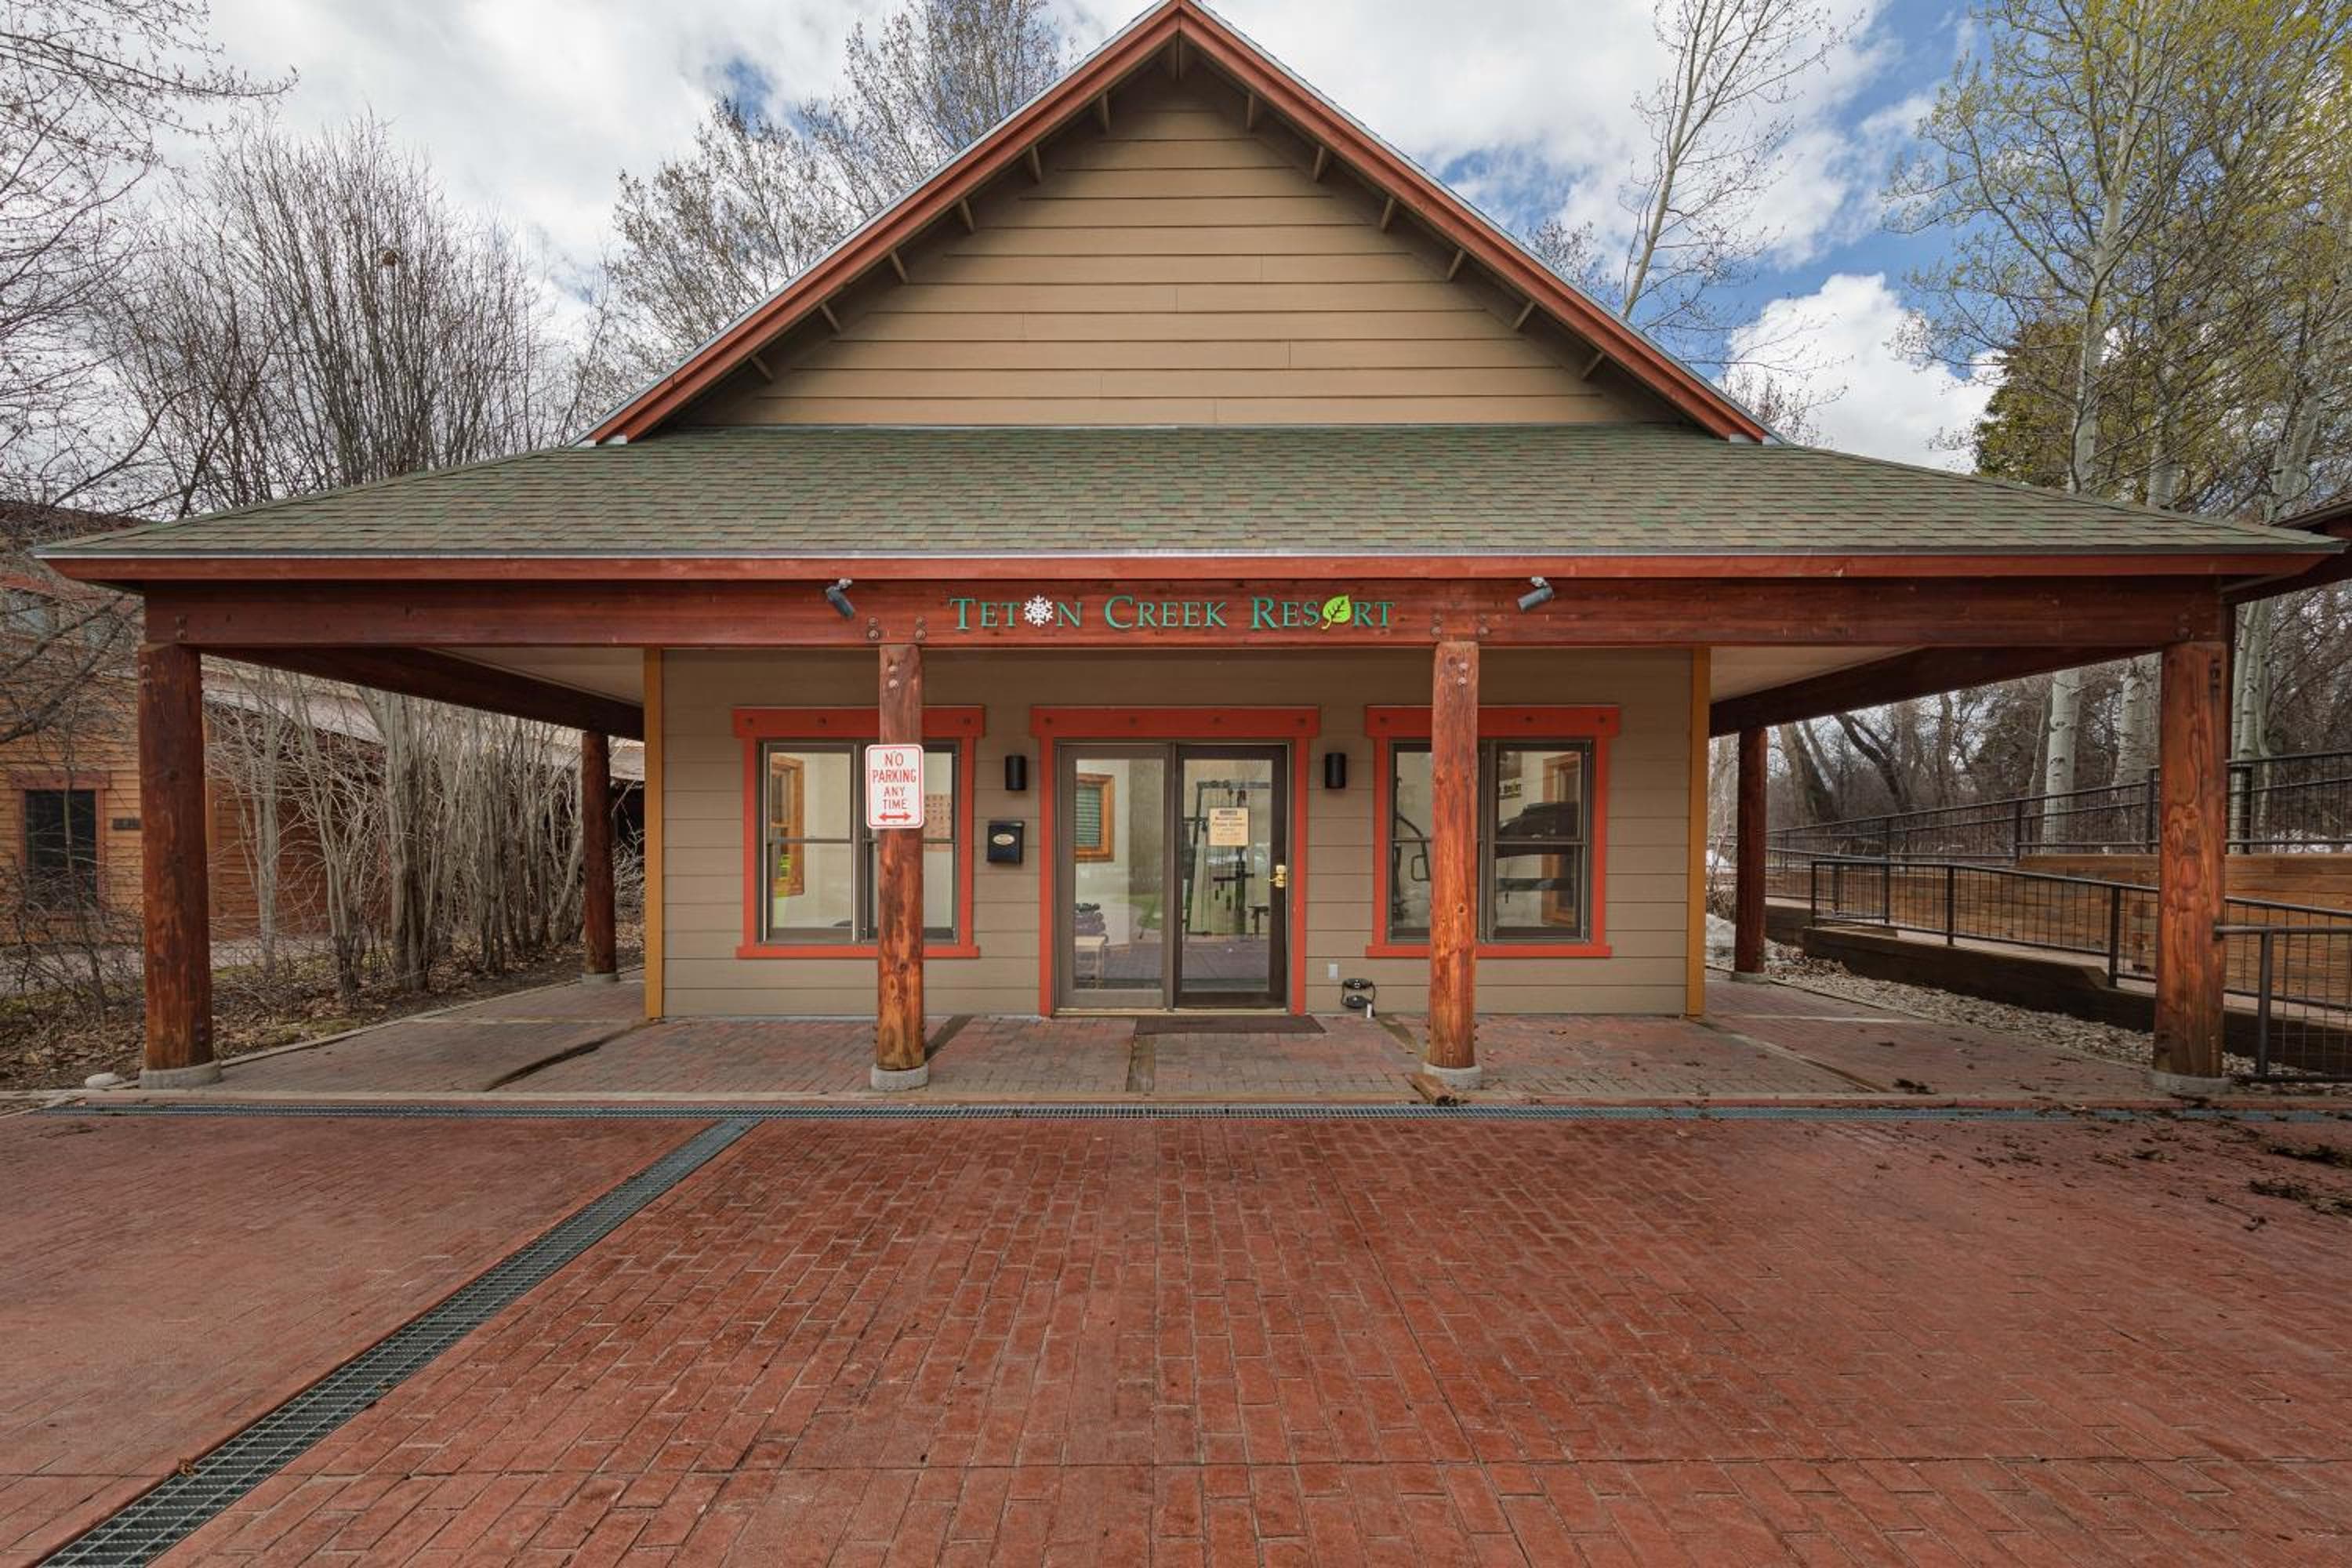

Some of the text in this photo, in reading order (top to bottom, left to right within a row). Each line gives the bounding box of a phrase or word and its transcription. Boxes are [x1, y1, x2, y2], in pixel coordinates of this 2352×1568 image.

[1103, 594, 1229, 629] CREEK
[884, 753, 905, 767] NO
[872, 769, 916, 783] PARKING
[884, 786, 906, 797] ANY
[883, 799, 907, 810] TIME
